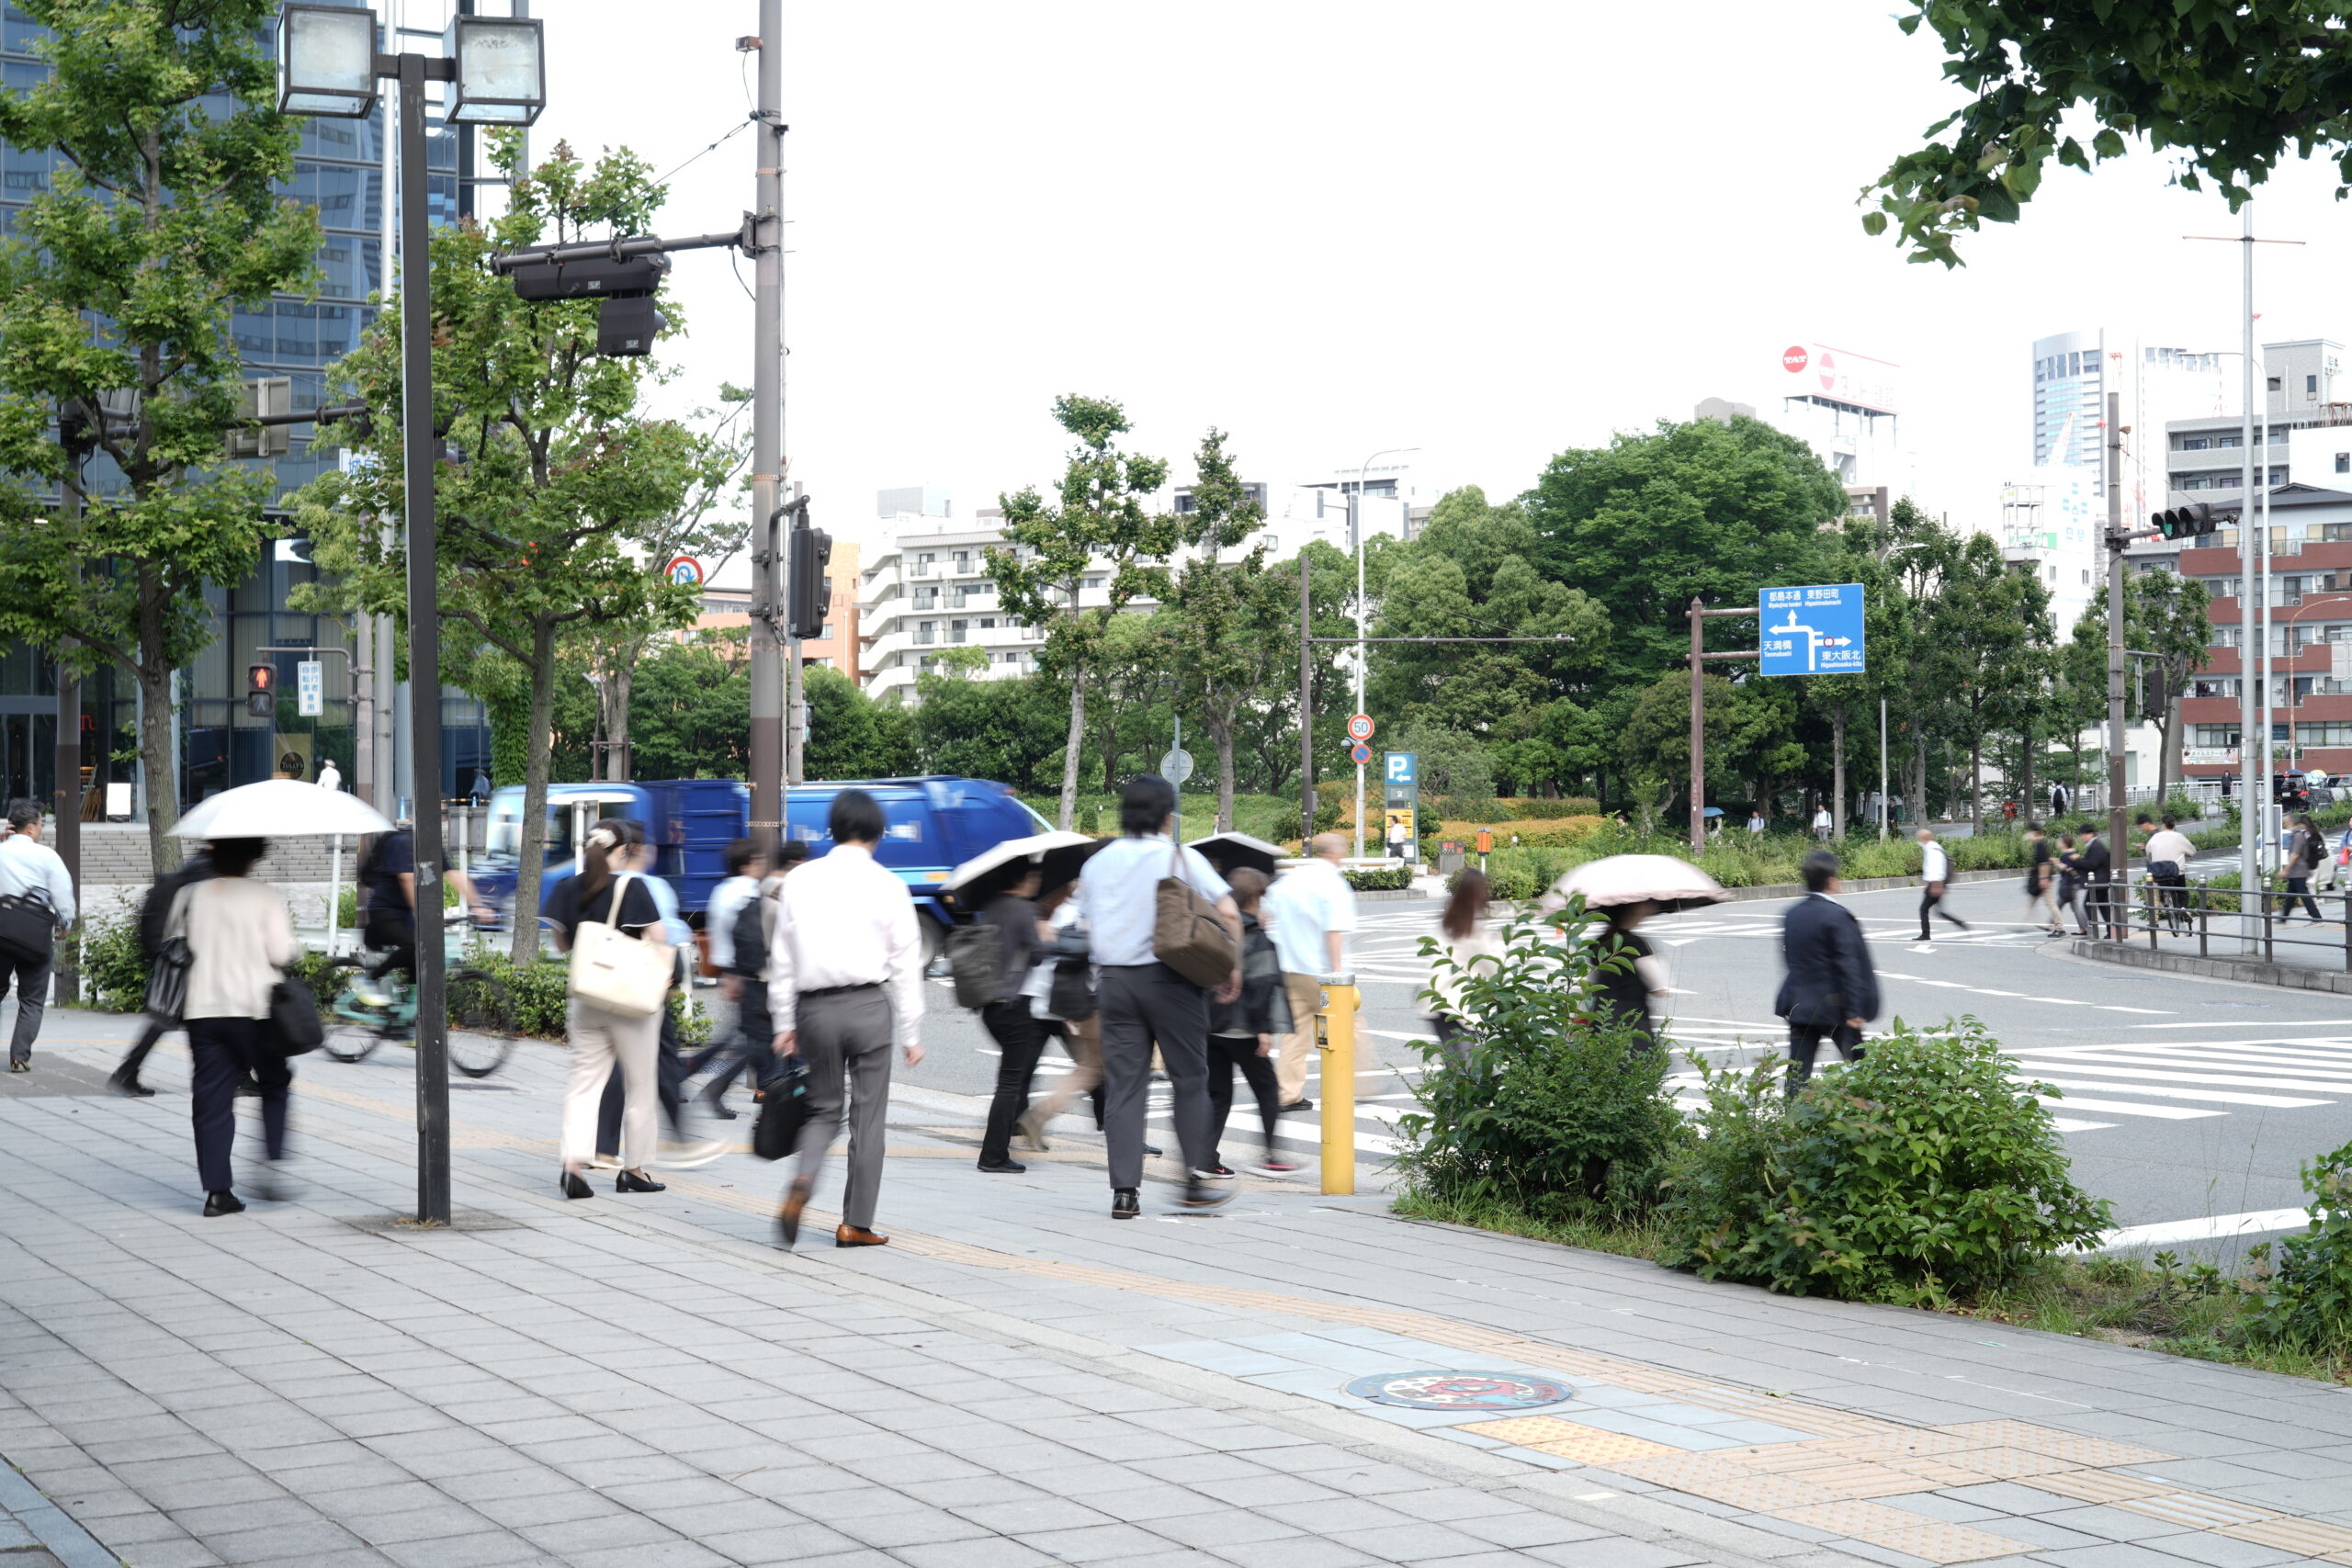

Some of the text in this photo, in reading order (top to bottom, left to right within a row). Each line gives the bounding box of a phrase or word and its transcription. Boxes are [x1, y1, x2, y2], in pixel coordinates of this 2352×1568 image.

[1763, 640, 1792, 650] 天満橋
[1822, 650, 1860, 660] 東大阪北
[1353, 721, 1369, 734] 50
[1388, 756, 1408, 779] P
